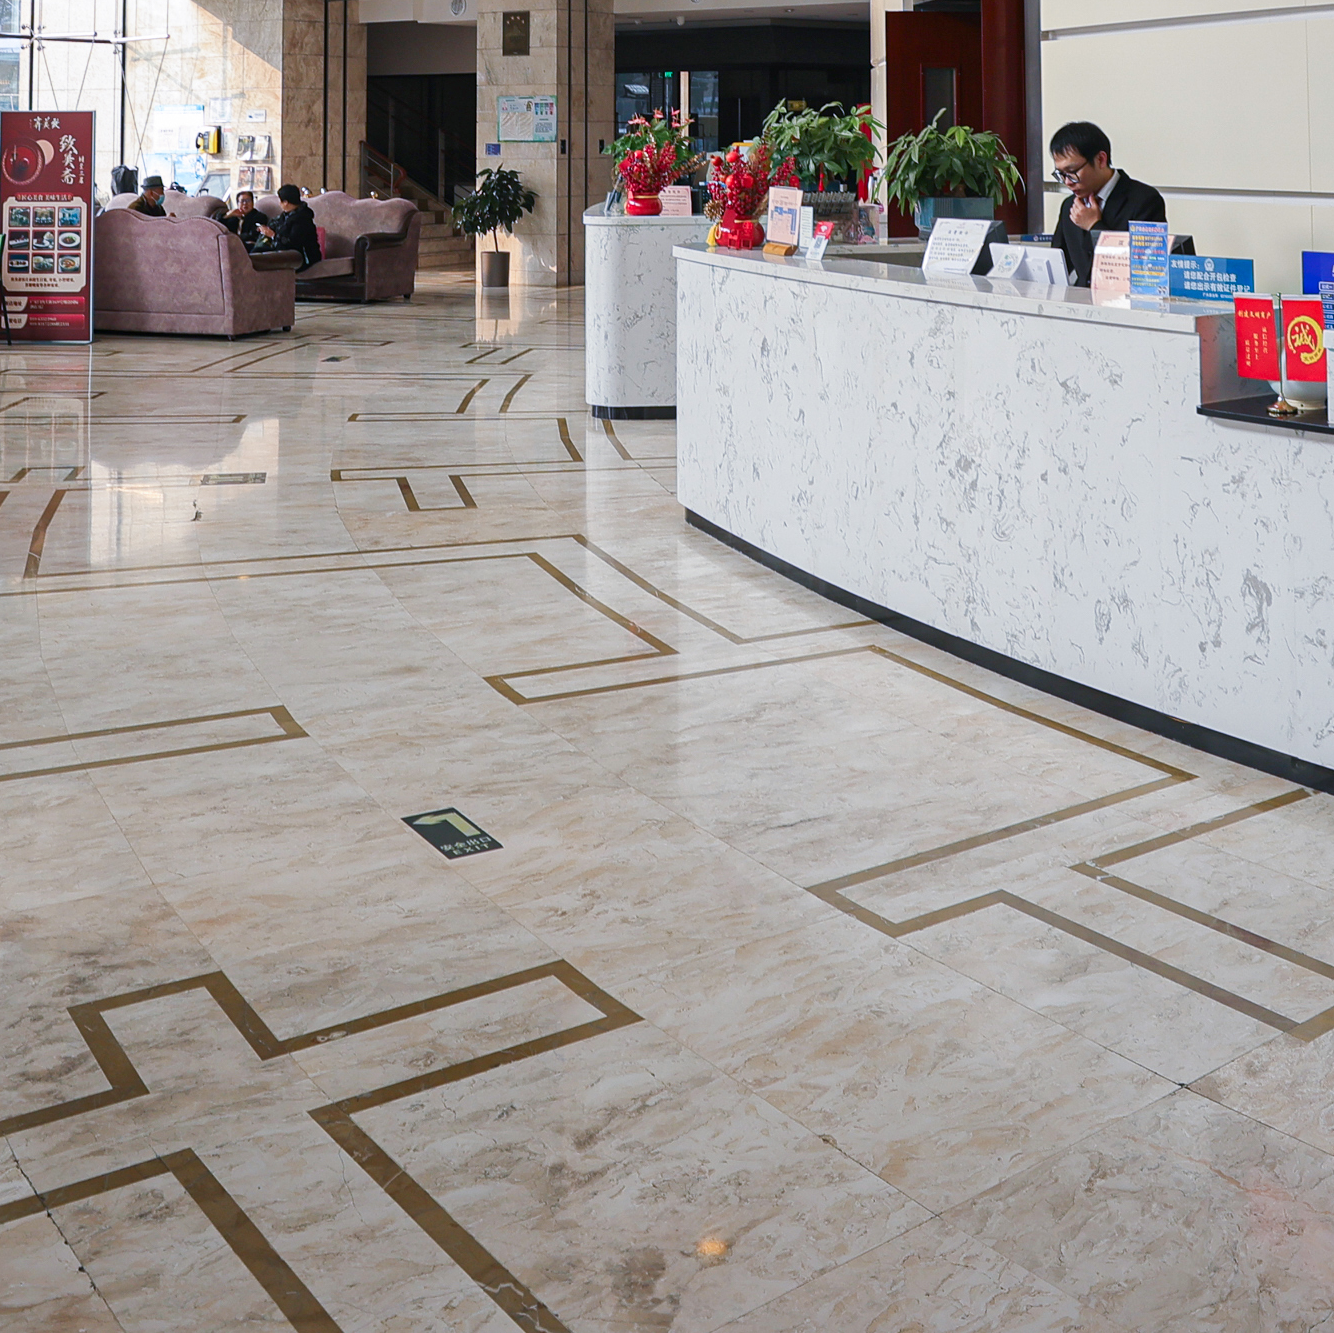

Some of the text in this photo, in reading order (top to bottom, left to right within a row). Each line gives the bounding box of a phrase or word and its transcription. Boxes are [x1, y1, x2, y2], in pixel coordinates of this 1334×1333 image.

[1183, 270, 1237, 283] 请您配合开包检查
[1183, 281, 1251, 294] 请您出示有效证件登记
[440, 836, 492, 852] 安全出口
[452, 843, 490, 856] EXIT
